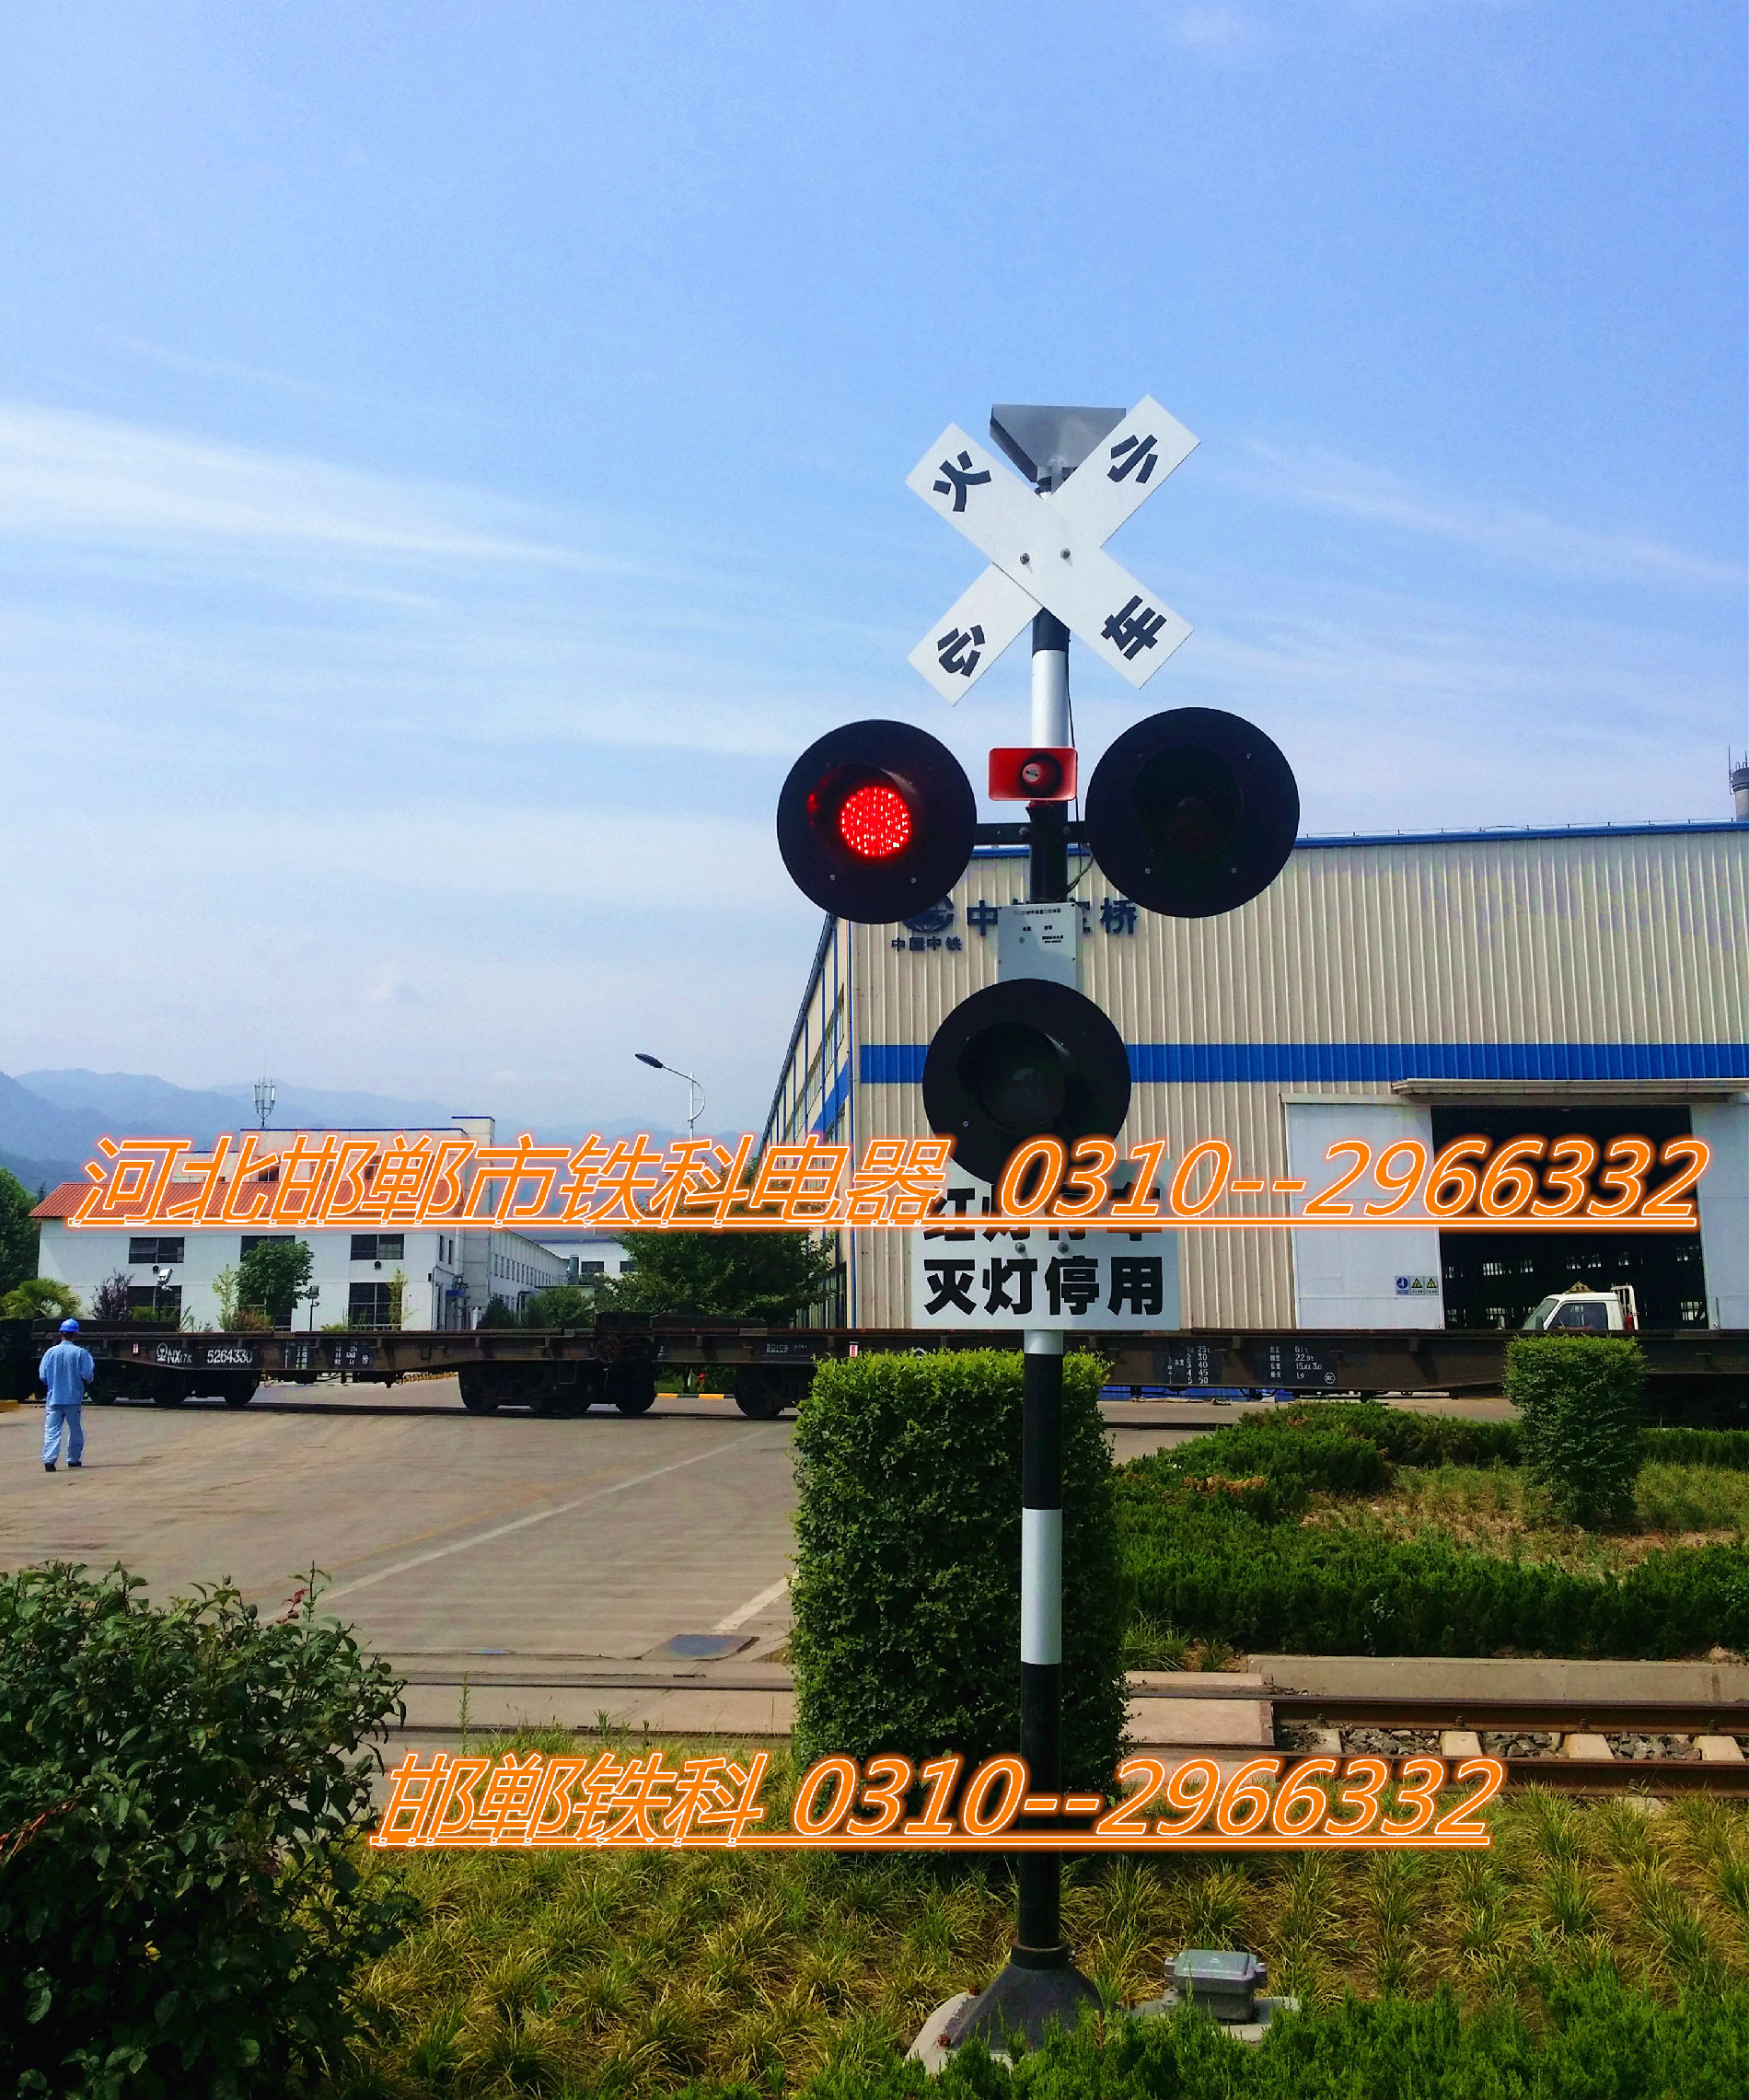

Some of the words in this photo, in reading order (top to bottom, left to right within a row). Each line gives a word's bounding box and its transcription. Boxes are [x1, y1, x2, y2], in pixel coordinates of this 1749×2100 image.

[1107, 434, 1159, 484] 小
[932, 450, 991, 512] 火
[1100, 595, 1167, 661] 车
[936, 624, 986, 678] 心
[923, 1255, 1164, 1316] 灭灯停用
[206, 1348, 253, 1363] 5264330
